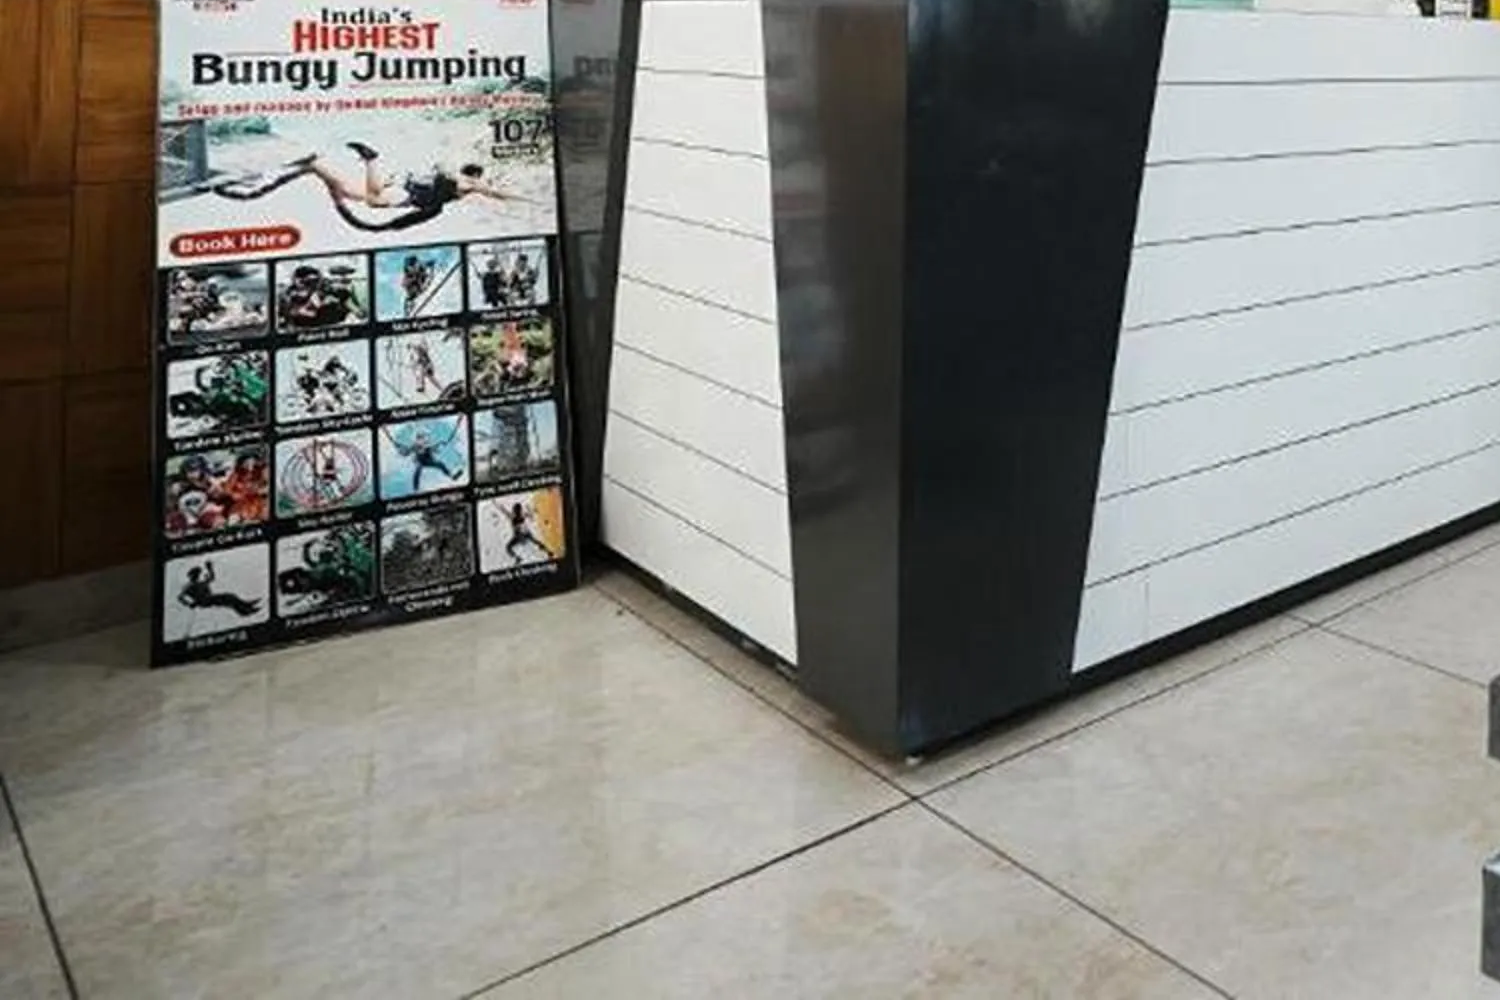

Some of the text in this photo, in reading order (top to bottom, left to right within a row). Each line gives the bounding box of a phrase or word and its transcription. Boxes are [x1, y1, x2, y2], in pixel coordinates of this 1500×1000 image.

[321, 7, 412, 25] India's
[293, 21, 440, 53] HIGHEST
[192, 49, 527, 91] Bungy Jumping
[488, 119, 543, 143] 107
[178, 232, 293, 254] Book Here
